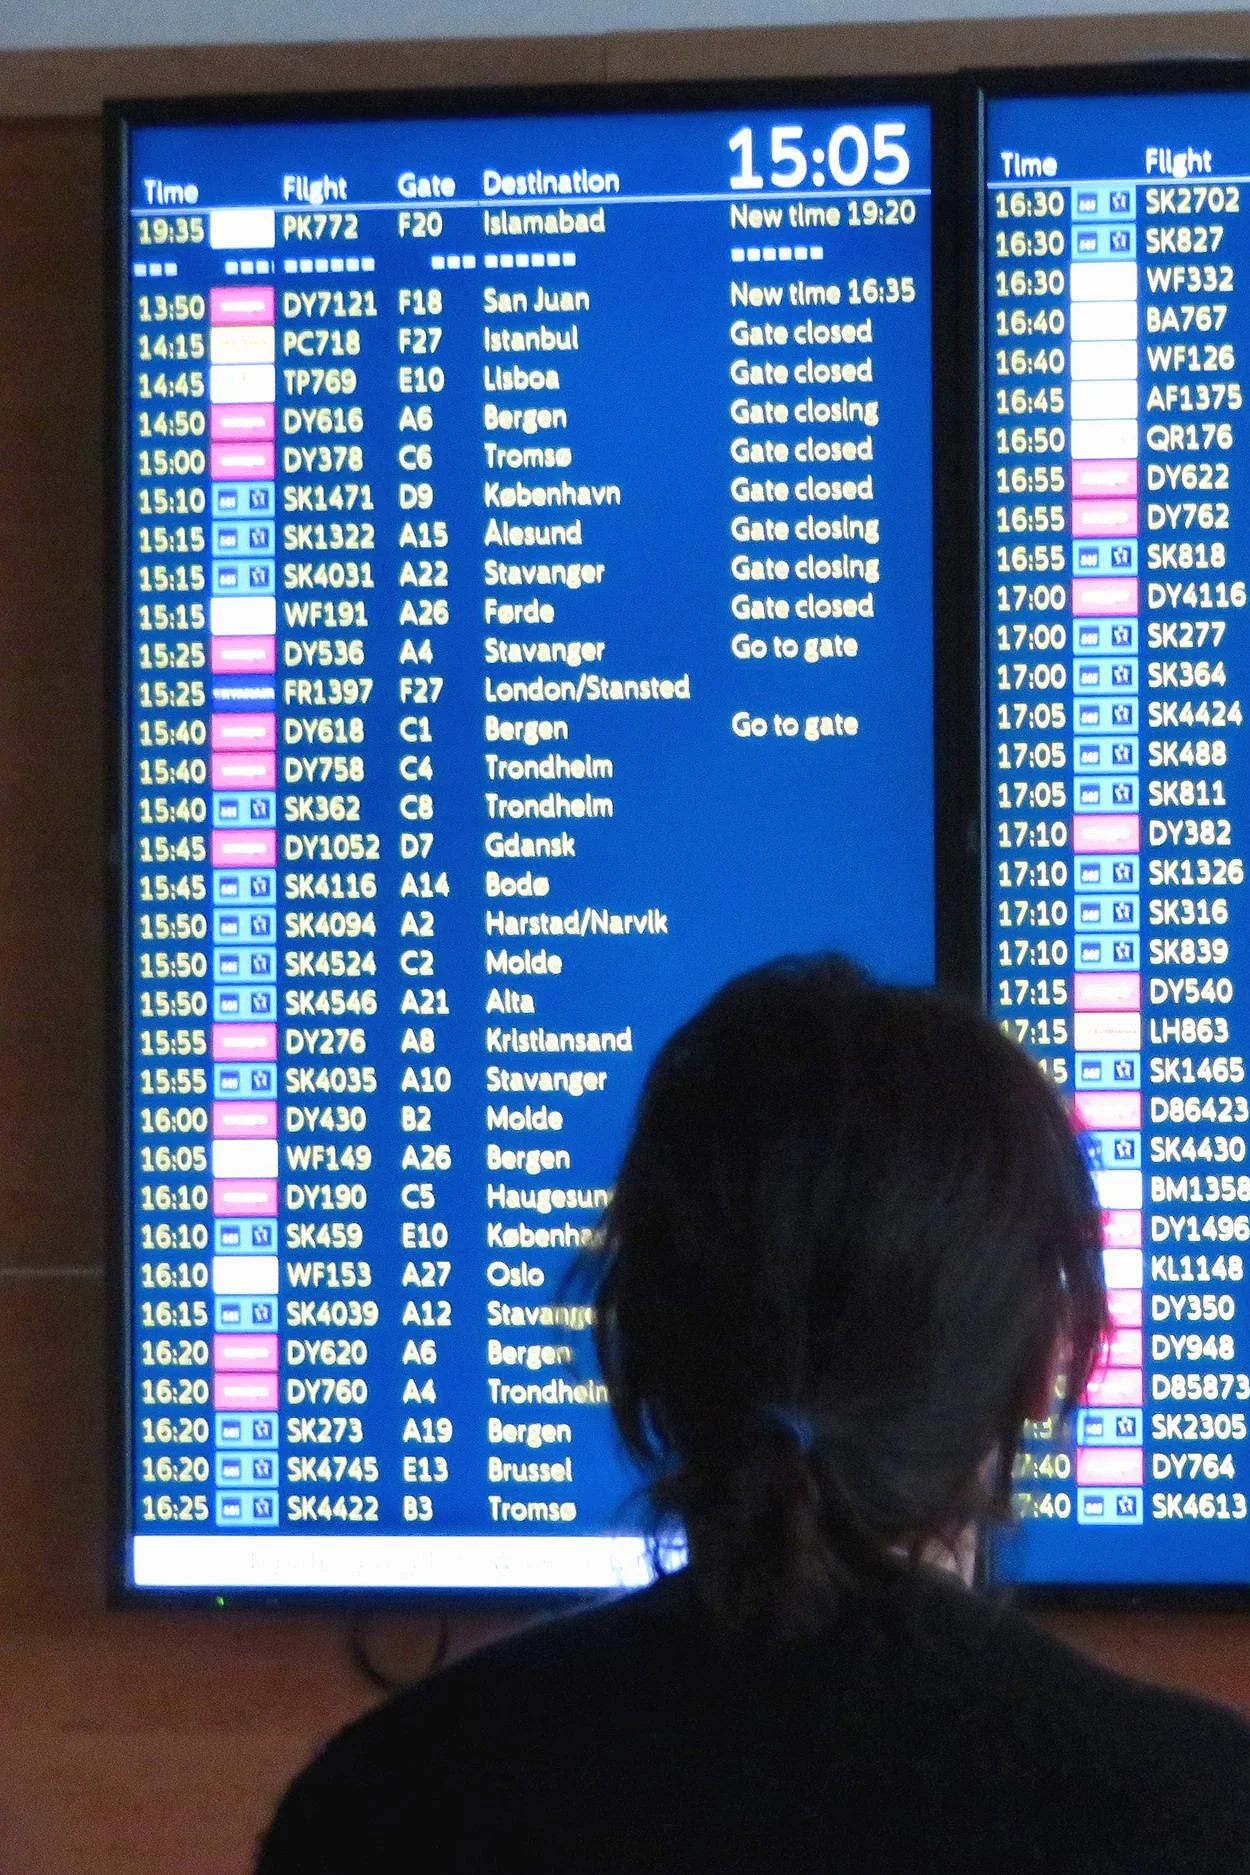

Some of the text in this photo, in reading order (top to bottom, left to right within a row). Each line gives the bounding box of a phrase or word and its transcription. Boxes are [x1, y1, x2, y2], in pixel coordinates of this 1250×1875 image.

[728, 122, 910, 190] 15:05
[1000, 151, 1058, 178] Time
[1145, 147, 1212, 179] Flight
[144, 168, 620, 206] Time Flight Gate Destination
[995, 190, 1065, 218] 16:30
[1145, 185, 1240, 215] SK2702
[138, 198, 916, 245] 19:35 PK772 F20 Islamabad New time 19:20
[138, 277, 916, 322] 13:50 DY7121 F18 San Juan New time 16:35
[996, 308, 1066, 336] 16:40
[1146, 304, 1228, 333] BA767
[139, 397, 880, 438] 14:50 DY616 A6 Bergen Gate closing
[996, 426, 1066, 454] 16:50
[1146, 423, 1234, 452] QR176
[139, 474, 874, 515] 15:10 SK1471 D9 København Gate closed
[997, 584, 1067, 612] 17:00
[1147, 581, 1247, 610] DY4116
[139, 681, 206, 708] 15:25
[284, 677, 374, 705] FR1397
[399, 676, 444, 704] F27
[485, 672, 691, 703] London/Stansted
[997, 781, 1067, 809] 17:05
[1148, 779, 1227, 807] SK811
[140, 907, 669, 940] 15:50 SK4094 A2 Harstad/Narvik
[998, 899, 1068, 927] 17:10
[1149, 898, 1229, 925] SK316
[140, 987, 535, 1017] 15:50 SK4546 A21 Alta
[140, 1025, 633, 1056] 15:55 DY276 A8 Kristiansand
[141, 1260, 545, 1288] 16:10 WF153 A27 Oslo
[1151, 1373, 1250, 1401] D85873
[142, 1456, 573, 1483] 16:20 SK4745 E13 Brussel
[142, 1495, 577, 1522] 16:25 SK4422 B3 Tromsø
[1152, 1492, 1248, 1520] SK4613
